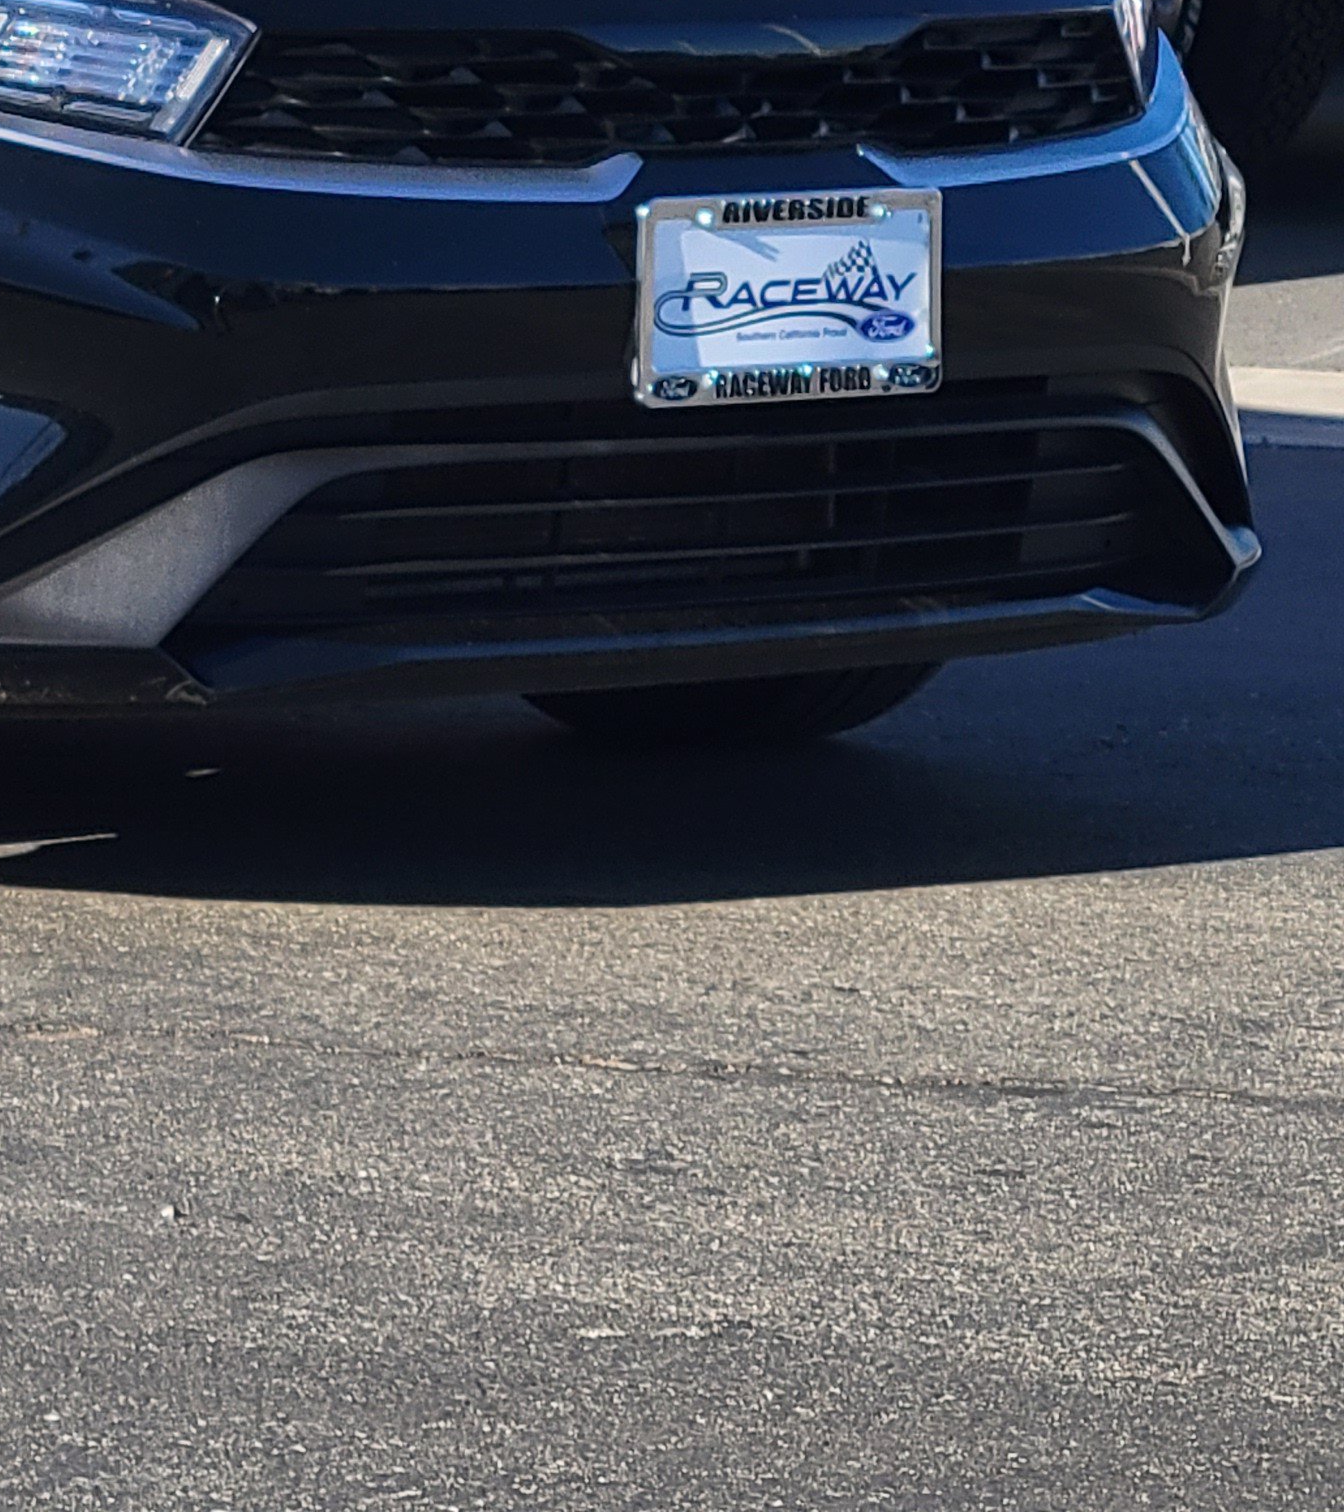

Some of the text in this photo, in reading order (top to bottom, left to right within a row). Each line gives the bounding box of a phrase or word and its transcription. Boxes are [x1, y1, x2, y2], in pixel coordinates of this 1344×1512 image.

[722, 196, 872, 224] RIVERSIDE
[680, 271, 918, 312] RACEWAY
[867, 314, 909, 339] Ford
[714, 369, 812, 399] RACEWAY
[818, 365, 872, 394] FORD
